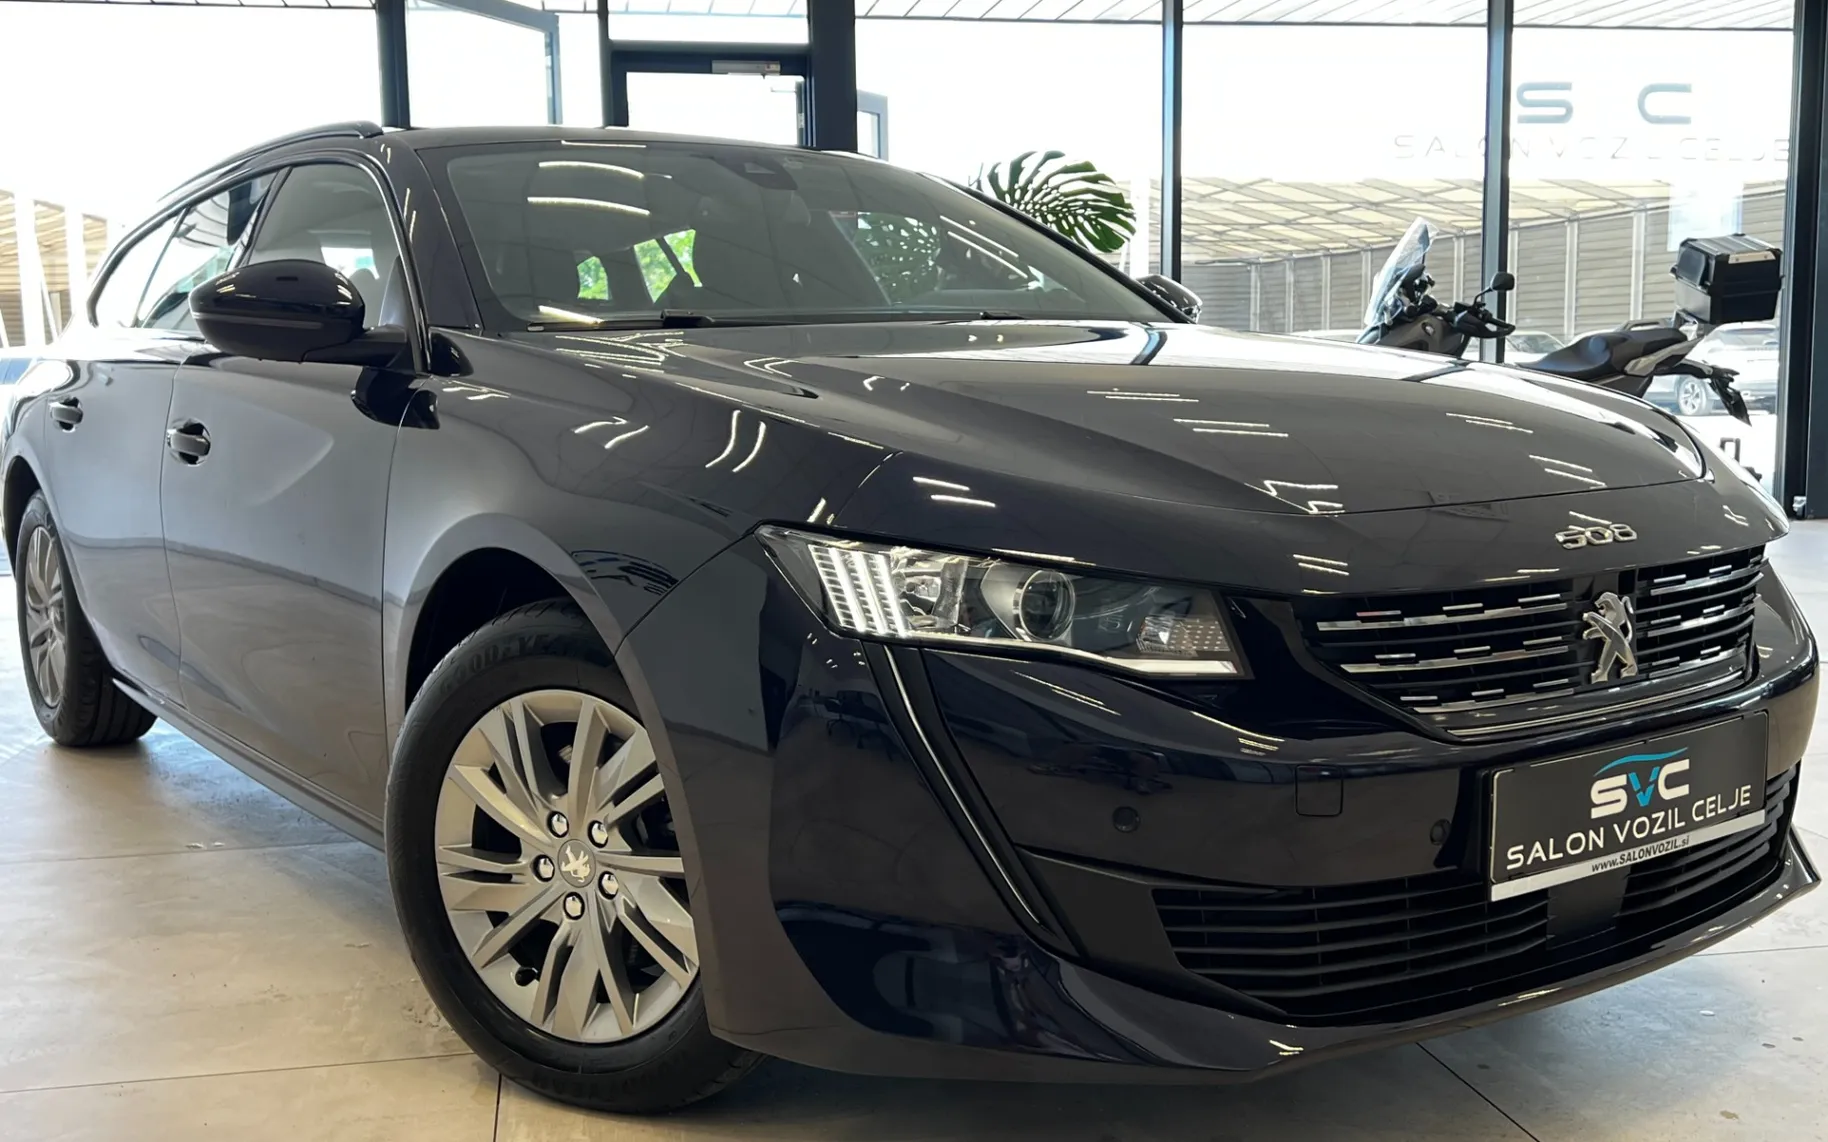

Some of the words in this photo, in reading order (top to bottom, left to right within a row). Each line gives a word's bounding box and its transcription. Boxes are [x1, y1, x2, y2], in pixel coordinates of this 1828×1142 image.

[1555, 523, 1637, 550] 508
[1590, 758, 1690, 820] SVC
[1506, 826, 1604, 871] SALON
[1613, 807, 1686, 844] VOZIL
[1691, 784, 1752, 822] CELJE
[1591, 835, 1690, 873] www.SALONVOZIL.si
